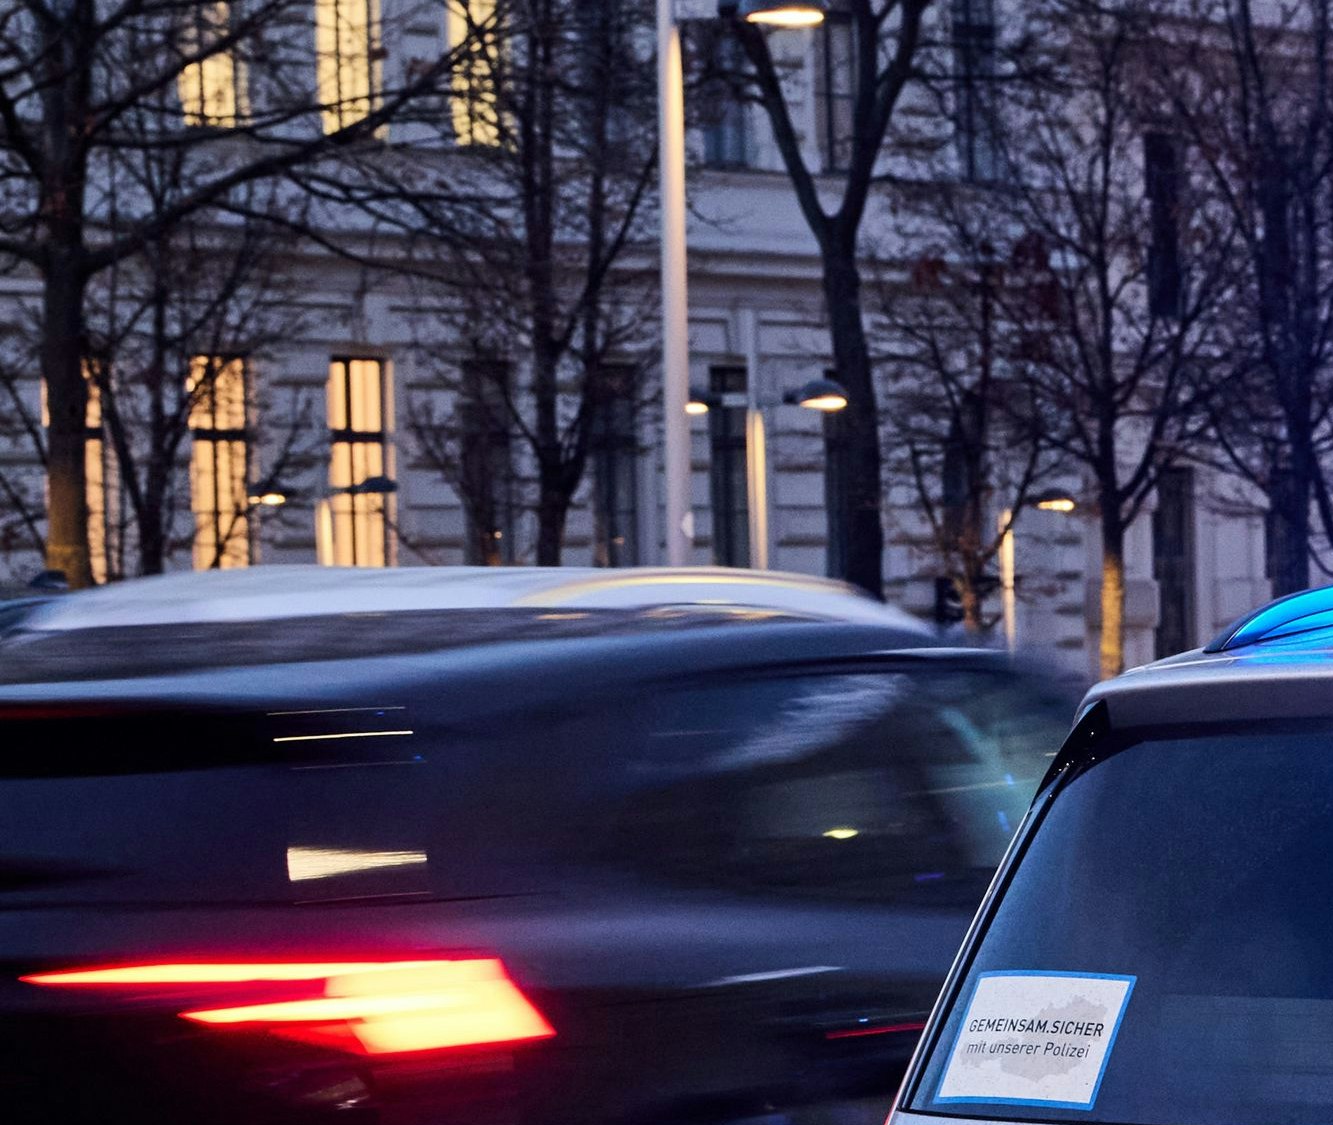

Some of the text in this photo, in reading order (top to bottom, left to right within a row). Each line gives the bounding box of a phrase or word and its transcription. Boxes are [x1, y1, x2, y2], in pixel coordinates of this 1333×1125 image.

[968, 1018, 1105, 1037] GEMEINSAM.SICHER
[966, 1040, 1091, 1059] mit unserer Polizei
